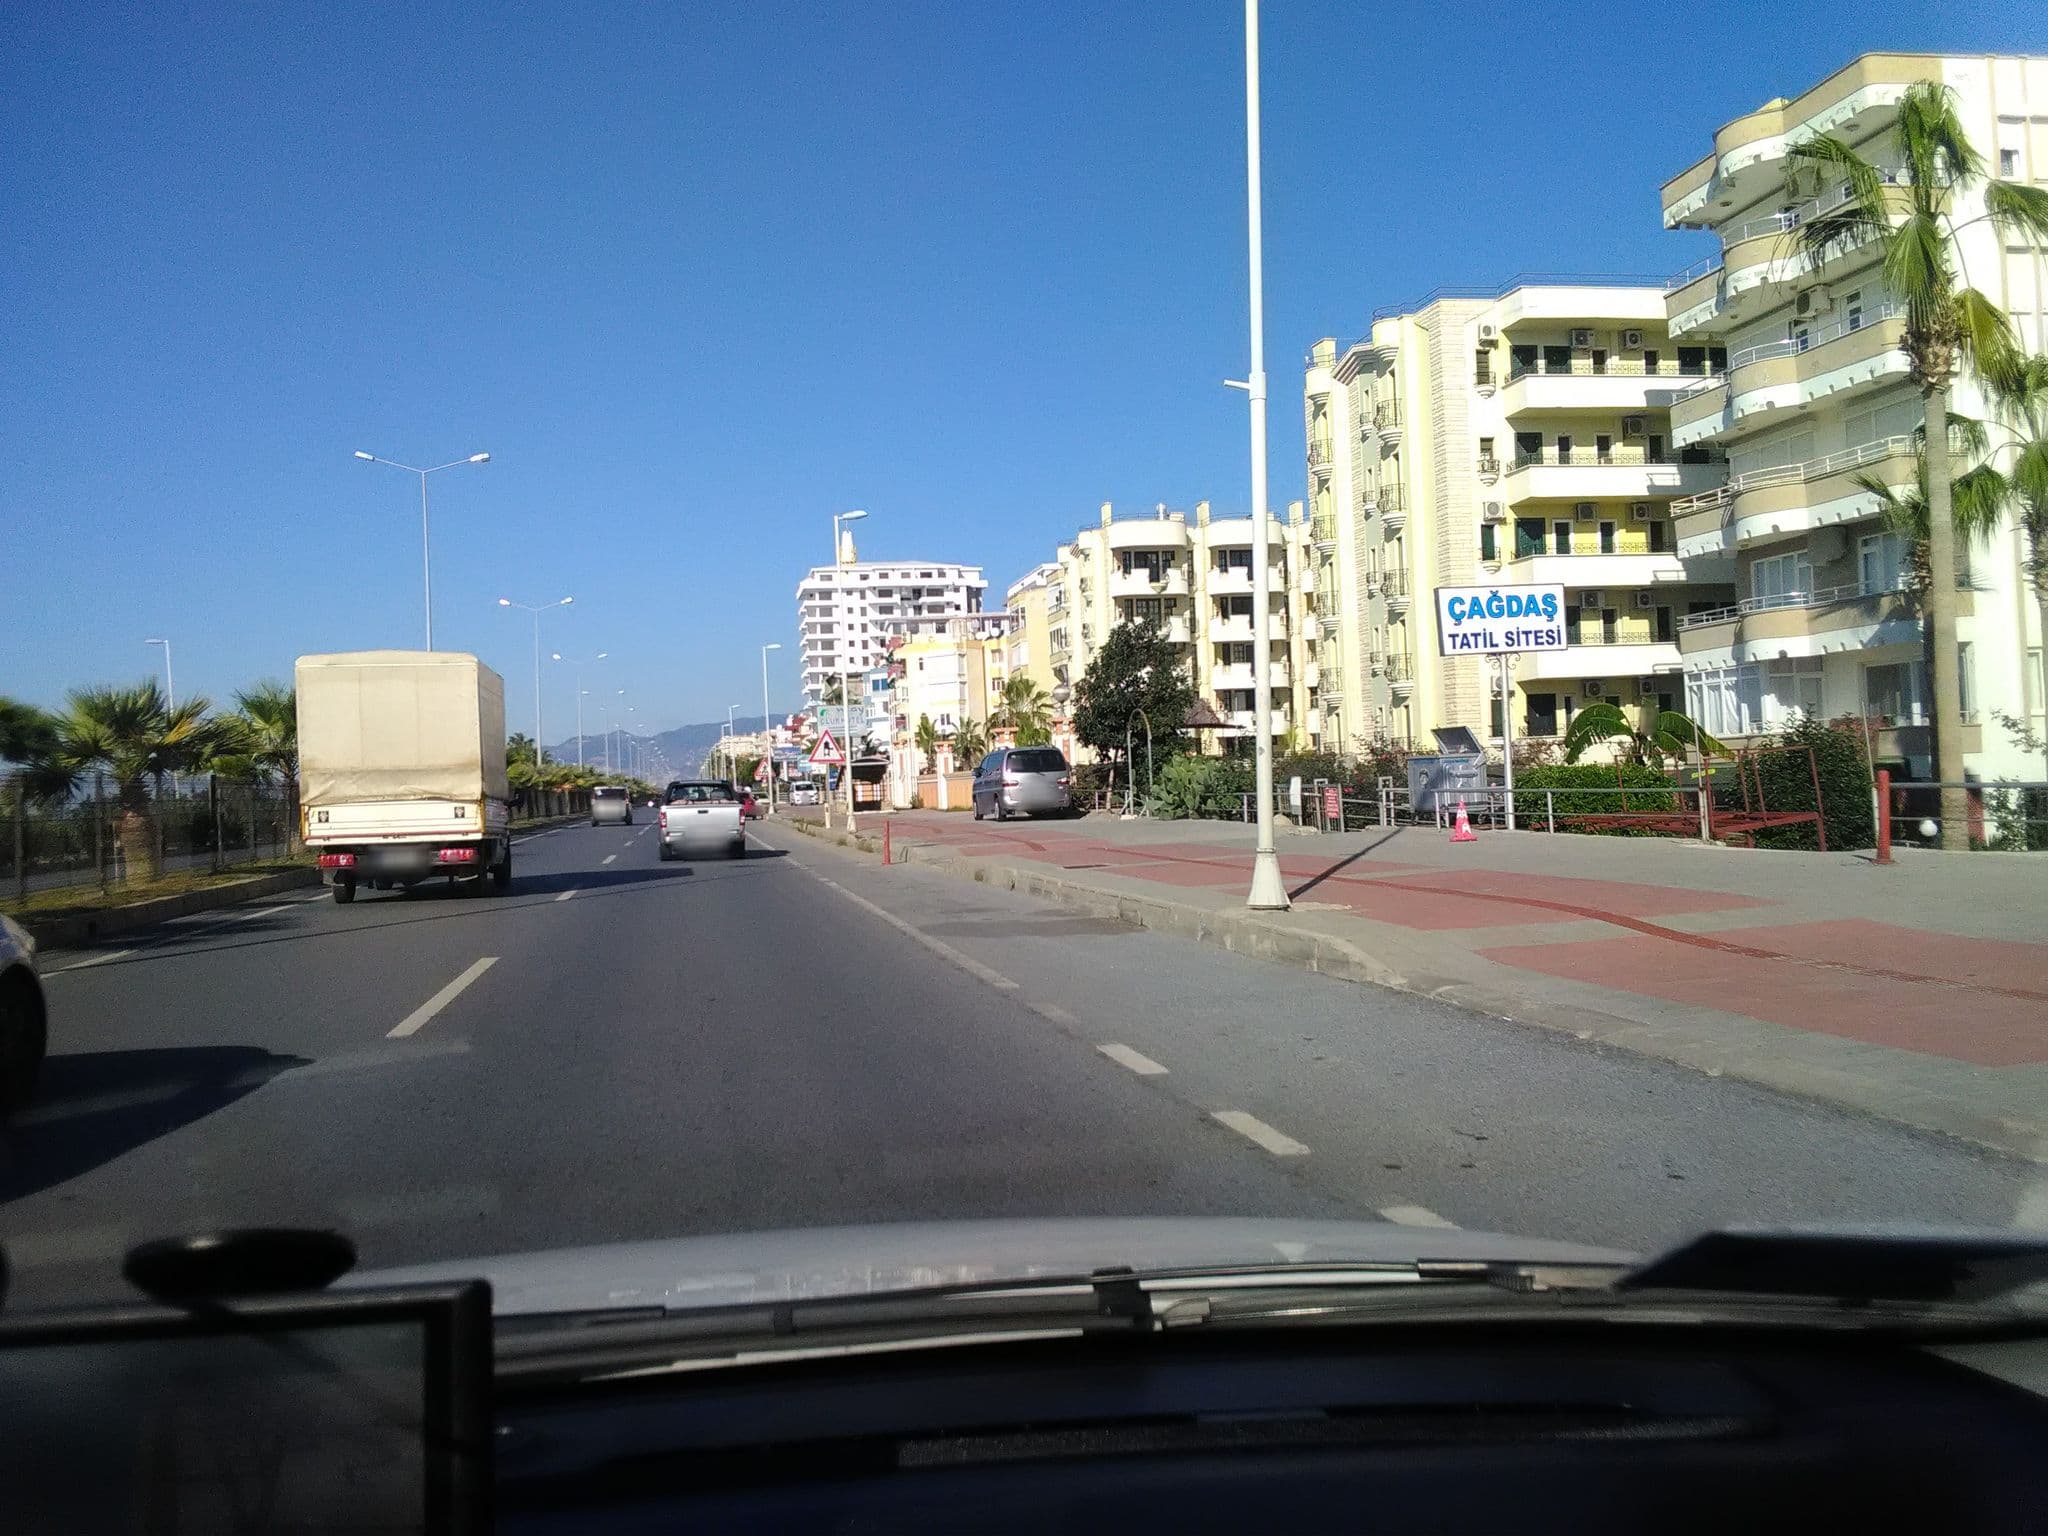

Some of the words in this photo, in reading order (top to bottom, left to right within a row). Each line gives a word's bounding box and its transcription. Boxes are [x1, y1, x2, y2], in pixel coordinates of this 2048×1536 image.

[1448, 590, 1558, 626] ÇAĞDAŞ
[1448, 628, 1499, 649] TATİL
[1505, 625, 1562, 647] SİTESİ
